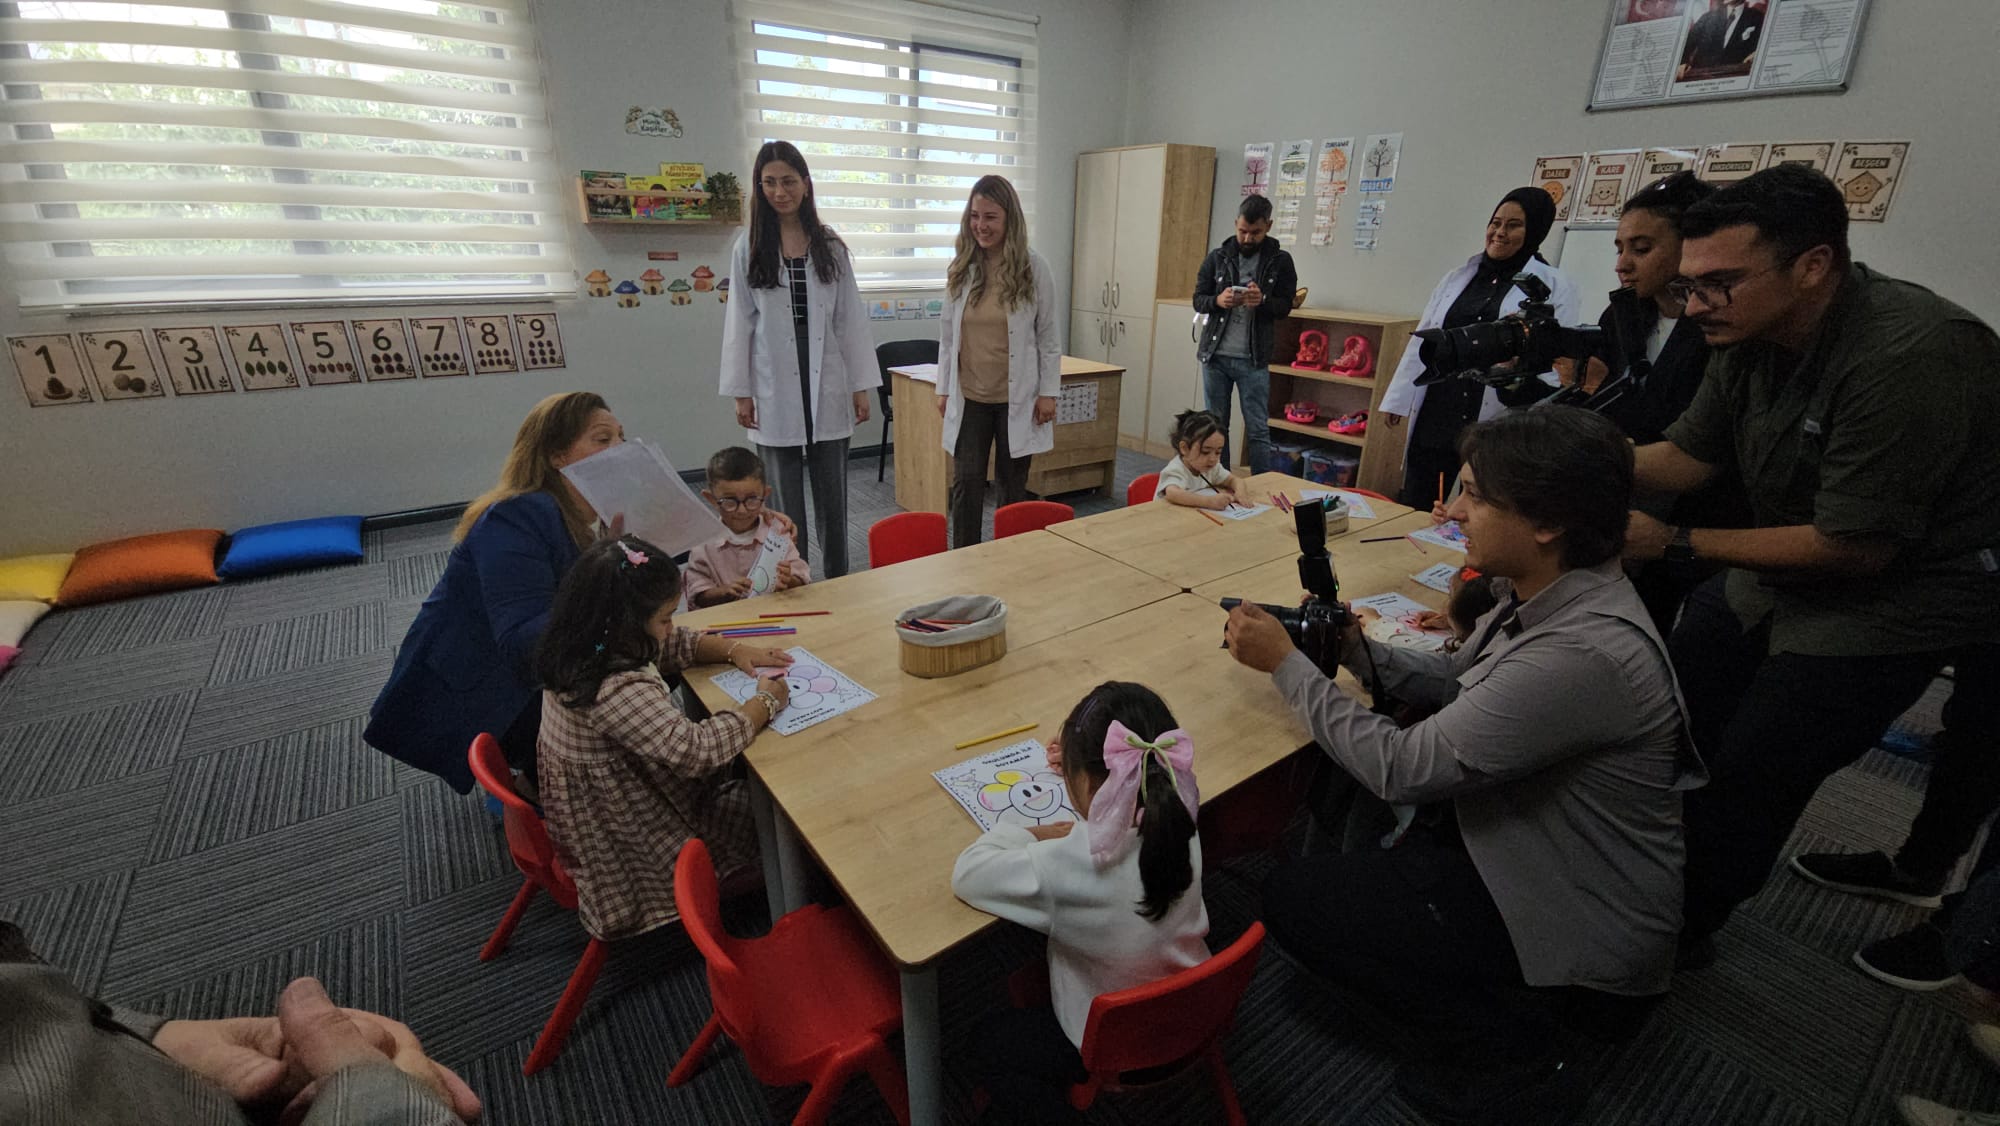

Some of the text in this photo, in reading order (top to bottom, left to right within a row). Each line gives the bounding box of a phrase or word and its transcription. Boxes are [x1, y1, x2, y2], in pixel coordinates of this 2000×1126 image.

[1600, 166, 1621, 174] KARE
[372, 327, 392, 351] 6
[426, 325, 445, 351] 7
[480, 322, 499, 346] 8
[529, 318, 546, 339] 9
[104, 339, 136, 371] 2
[179, 336, 204, 364] 3
[247, 332, 269, 357] 4
[312, 331, 335, 359] 5
[34, 344, 57, 375] 1
